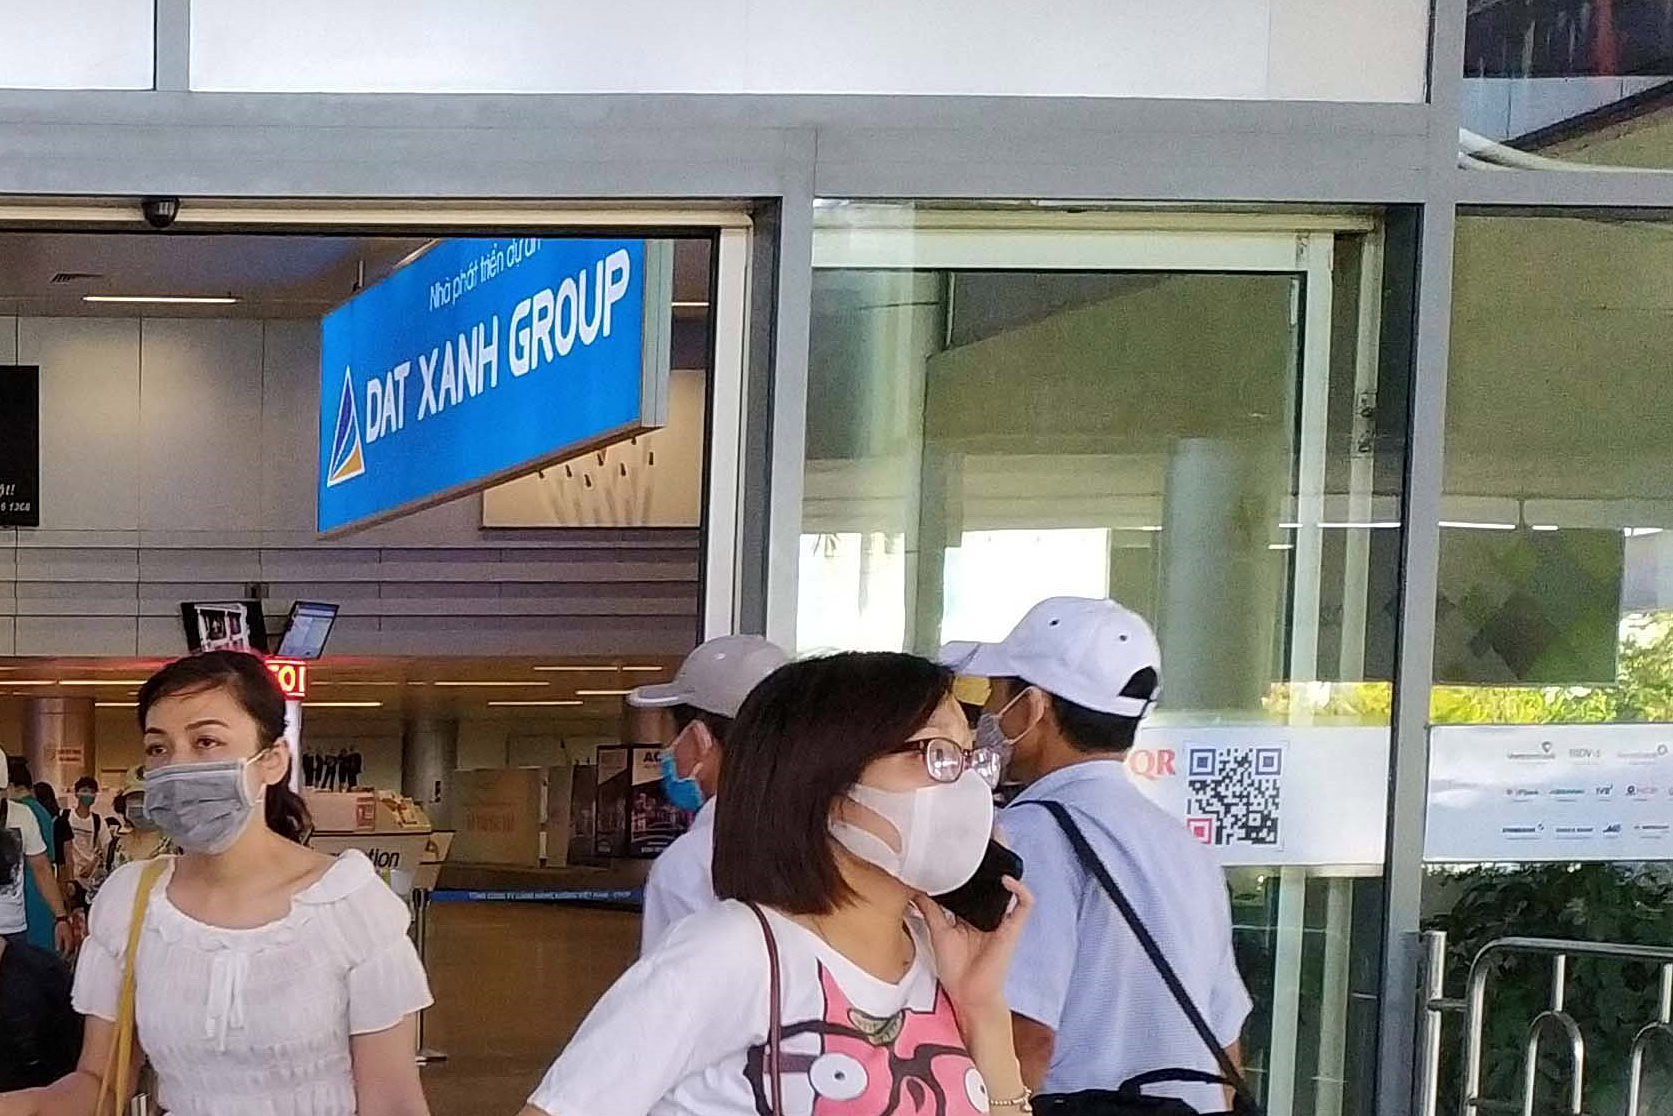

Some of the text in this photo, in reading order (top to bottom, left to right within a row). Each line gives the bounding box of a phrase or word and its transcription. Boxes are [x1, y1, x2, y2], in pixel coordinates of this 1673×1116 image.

[365, 248, 631, 444] DAT XANH GROUP
[1128, 749, 1175, 779] QR
